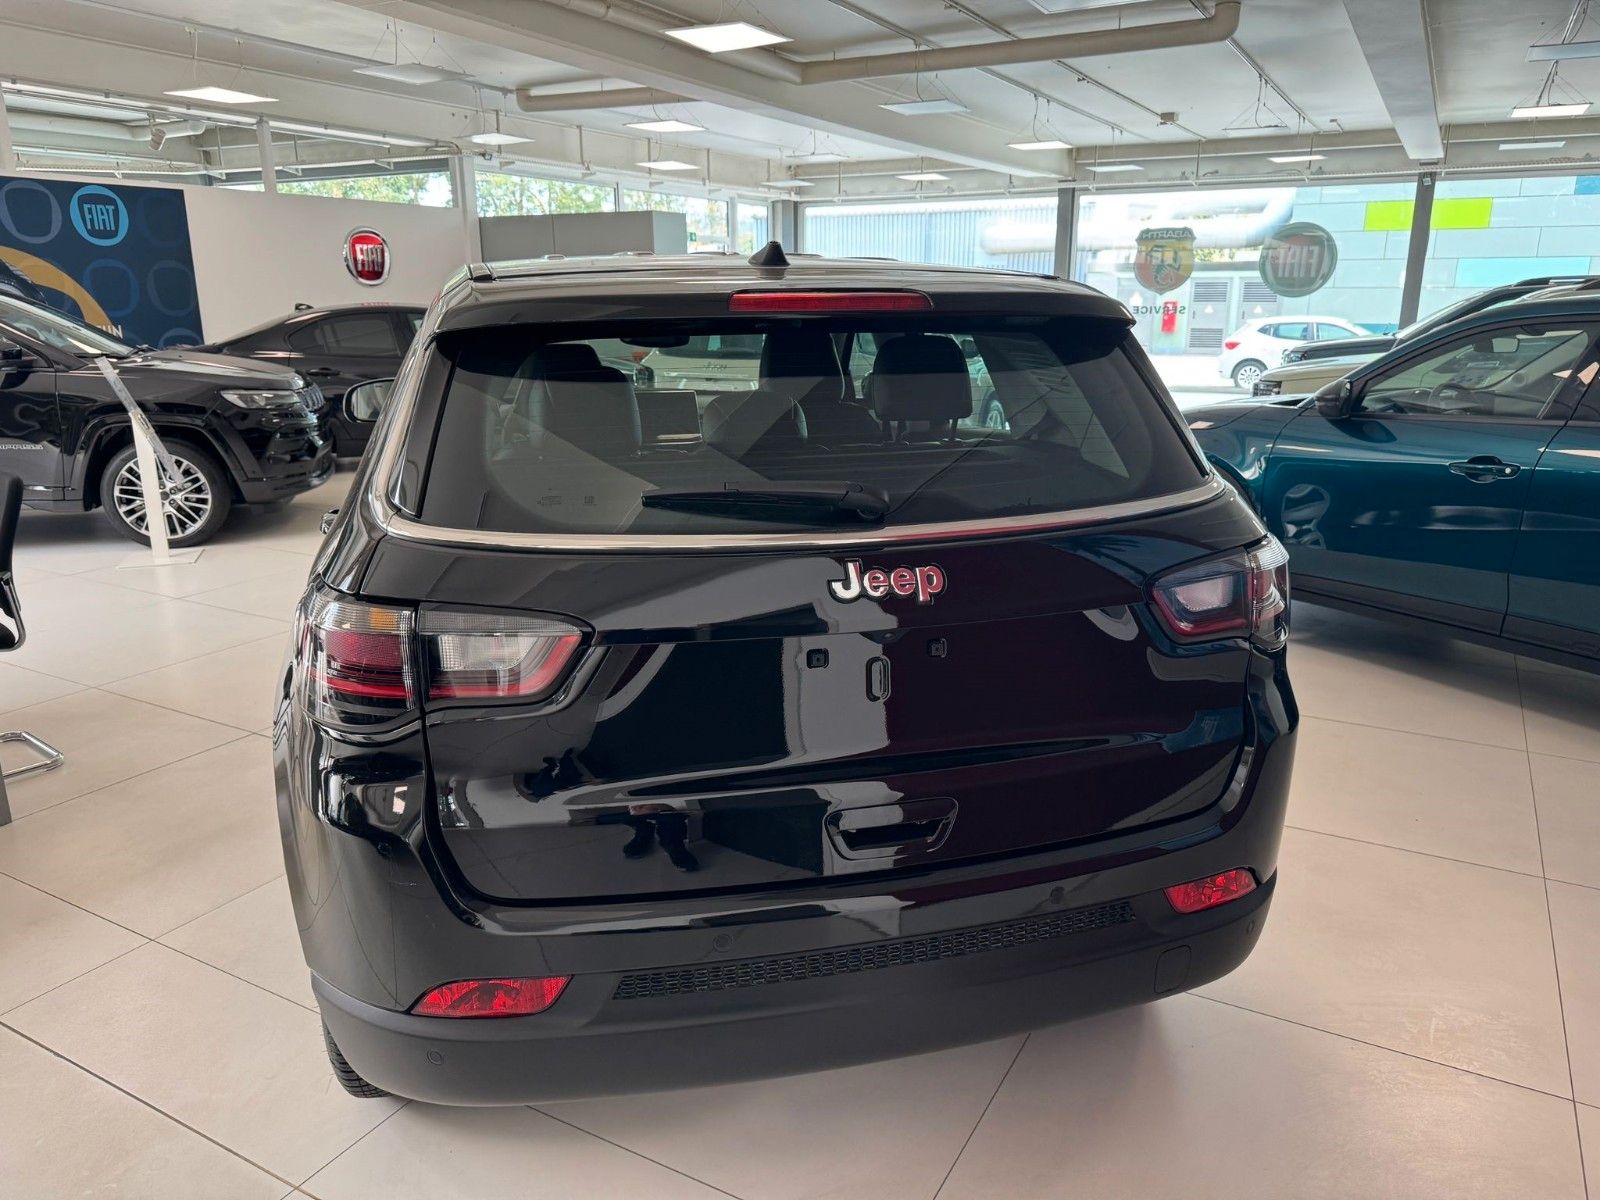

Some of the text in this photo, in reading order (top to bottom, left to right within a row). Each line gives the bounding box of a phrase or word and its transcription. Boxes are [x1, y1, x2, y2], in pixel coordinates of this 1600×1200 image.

[83, 203, 116, 231] FIAT
[354, 243, 383, 272] FIAT
[831, 560, 944, 602] Jeep
